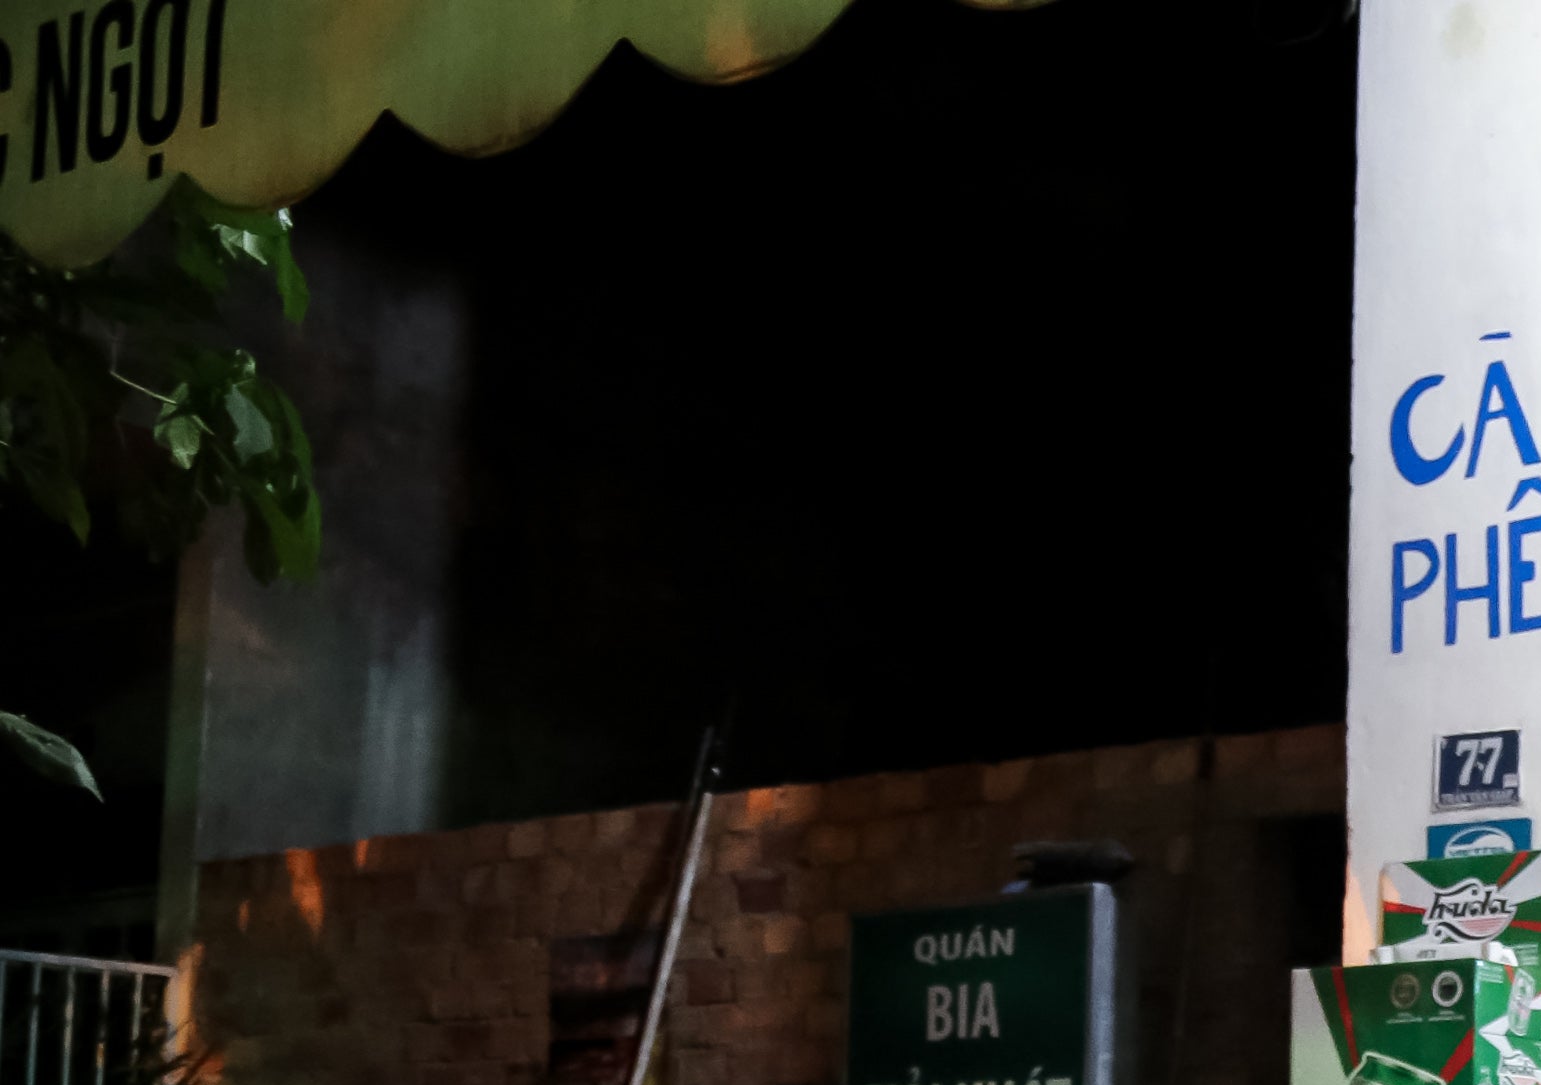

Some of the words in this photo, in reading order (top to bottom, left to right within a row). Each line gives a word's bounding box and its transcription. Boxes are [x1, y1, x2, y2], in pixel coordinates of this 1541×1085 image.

[1455, 737, 1503, 786] 77
[913, 924, 1016, 966] QUÁN
[926, 981, 1001, 1042] BIA
